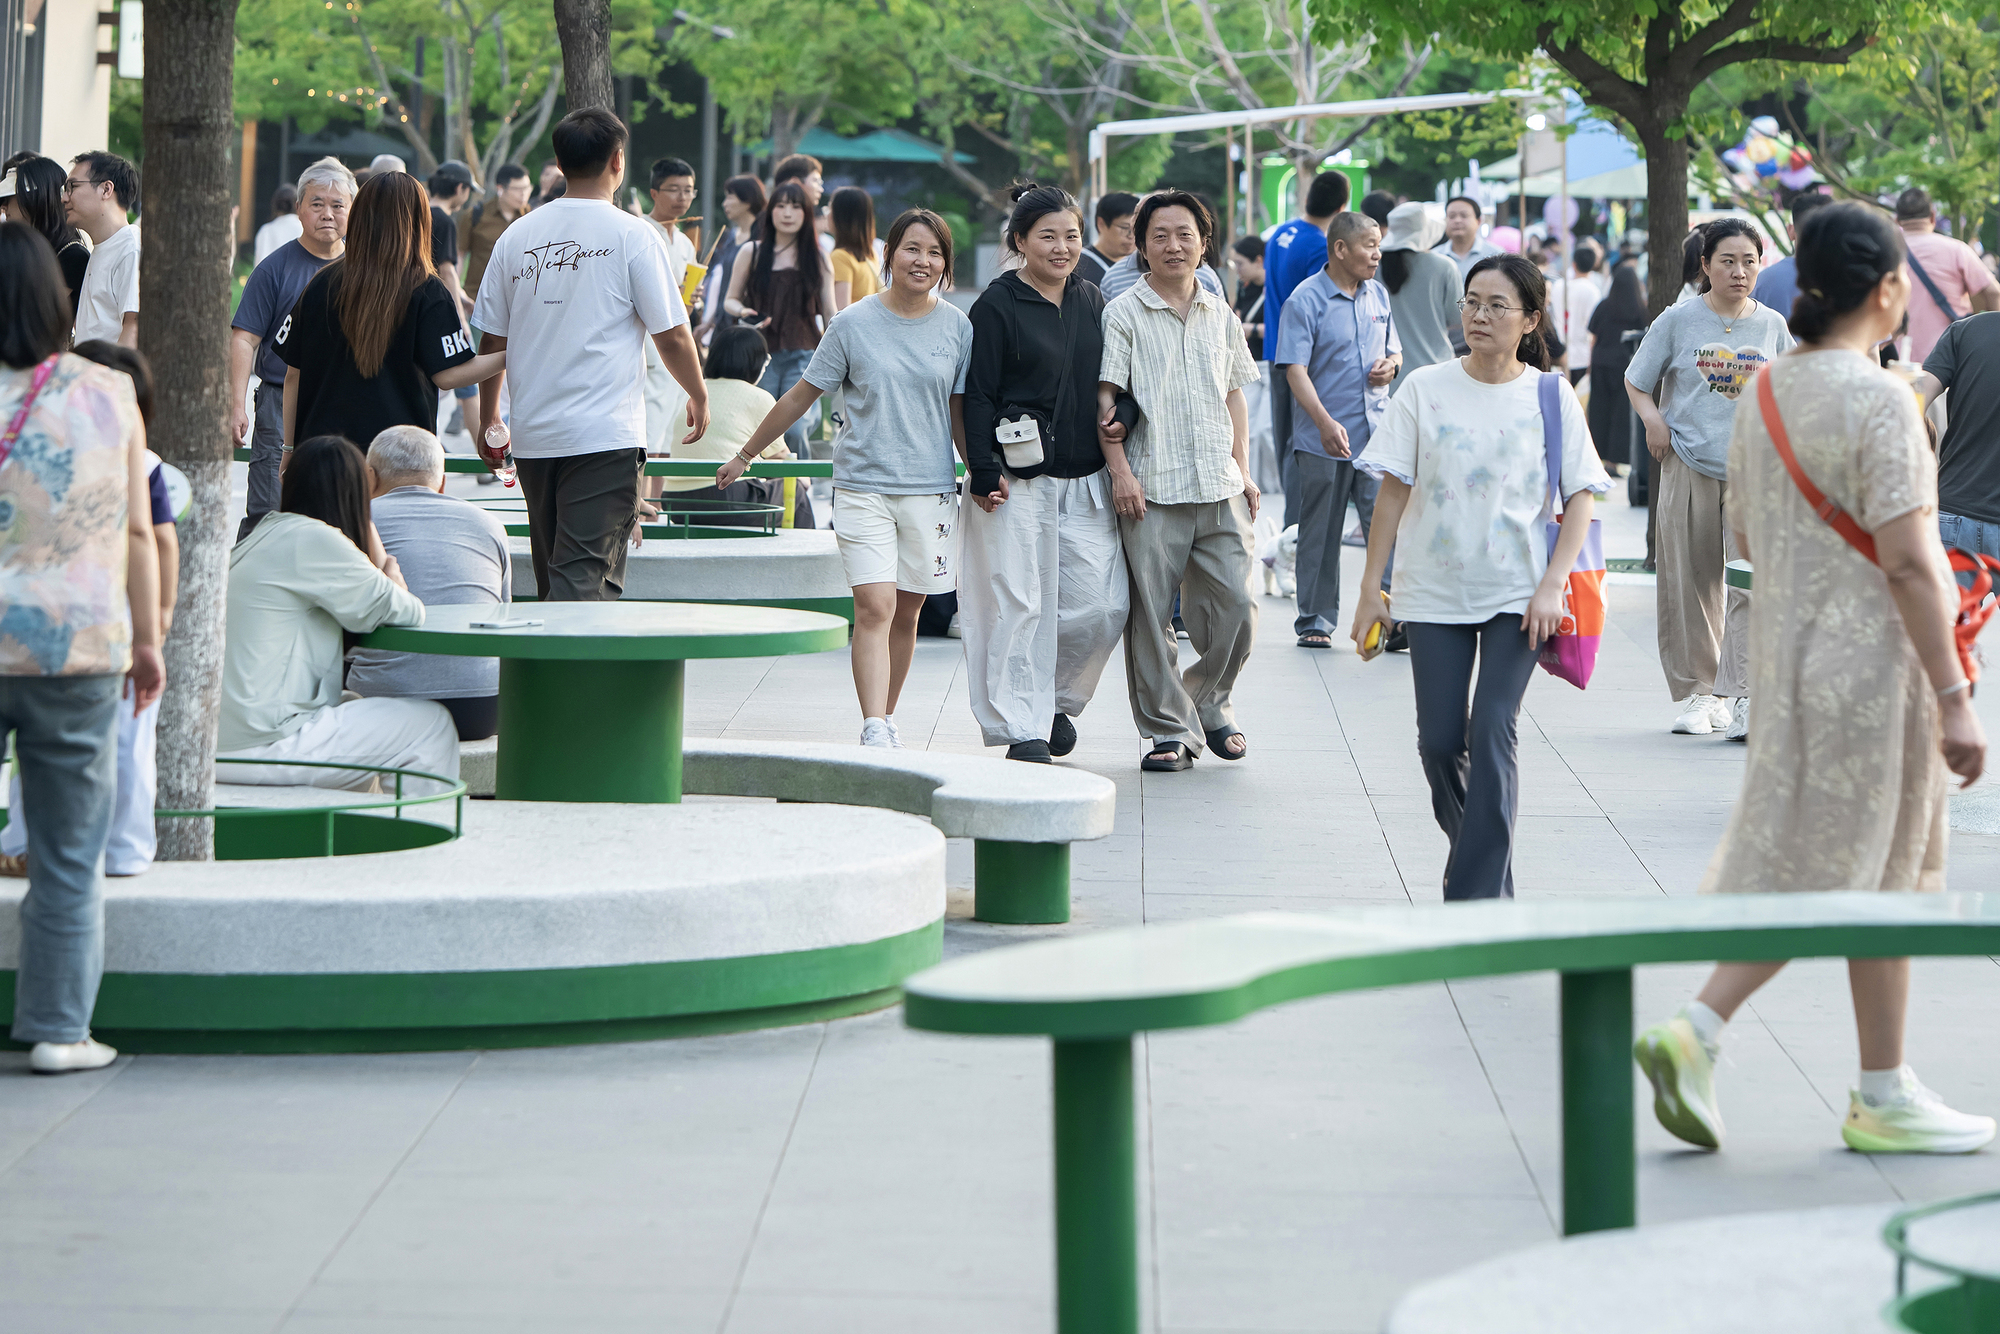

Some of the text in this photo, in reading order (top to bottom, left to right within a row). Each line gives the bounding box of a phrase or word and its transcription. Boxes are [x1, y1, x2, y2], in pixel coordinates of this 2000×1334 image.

[441, 329, 470, 358] BK
[1693, 349, 1714, 357] SUN
[1718, 350, 1735, 360] For
[1726, 362, 1743, 371] For
[1707, 373, 1732, 383] And
